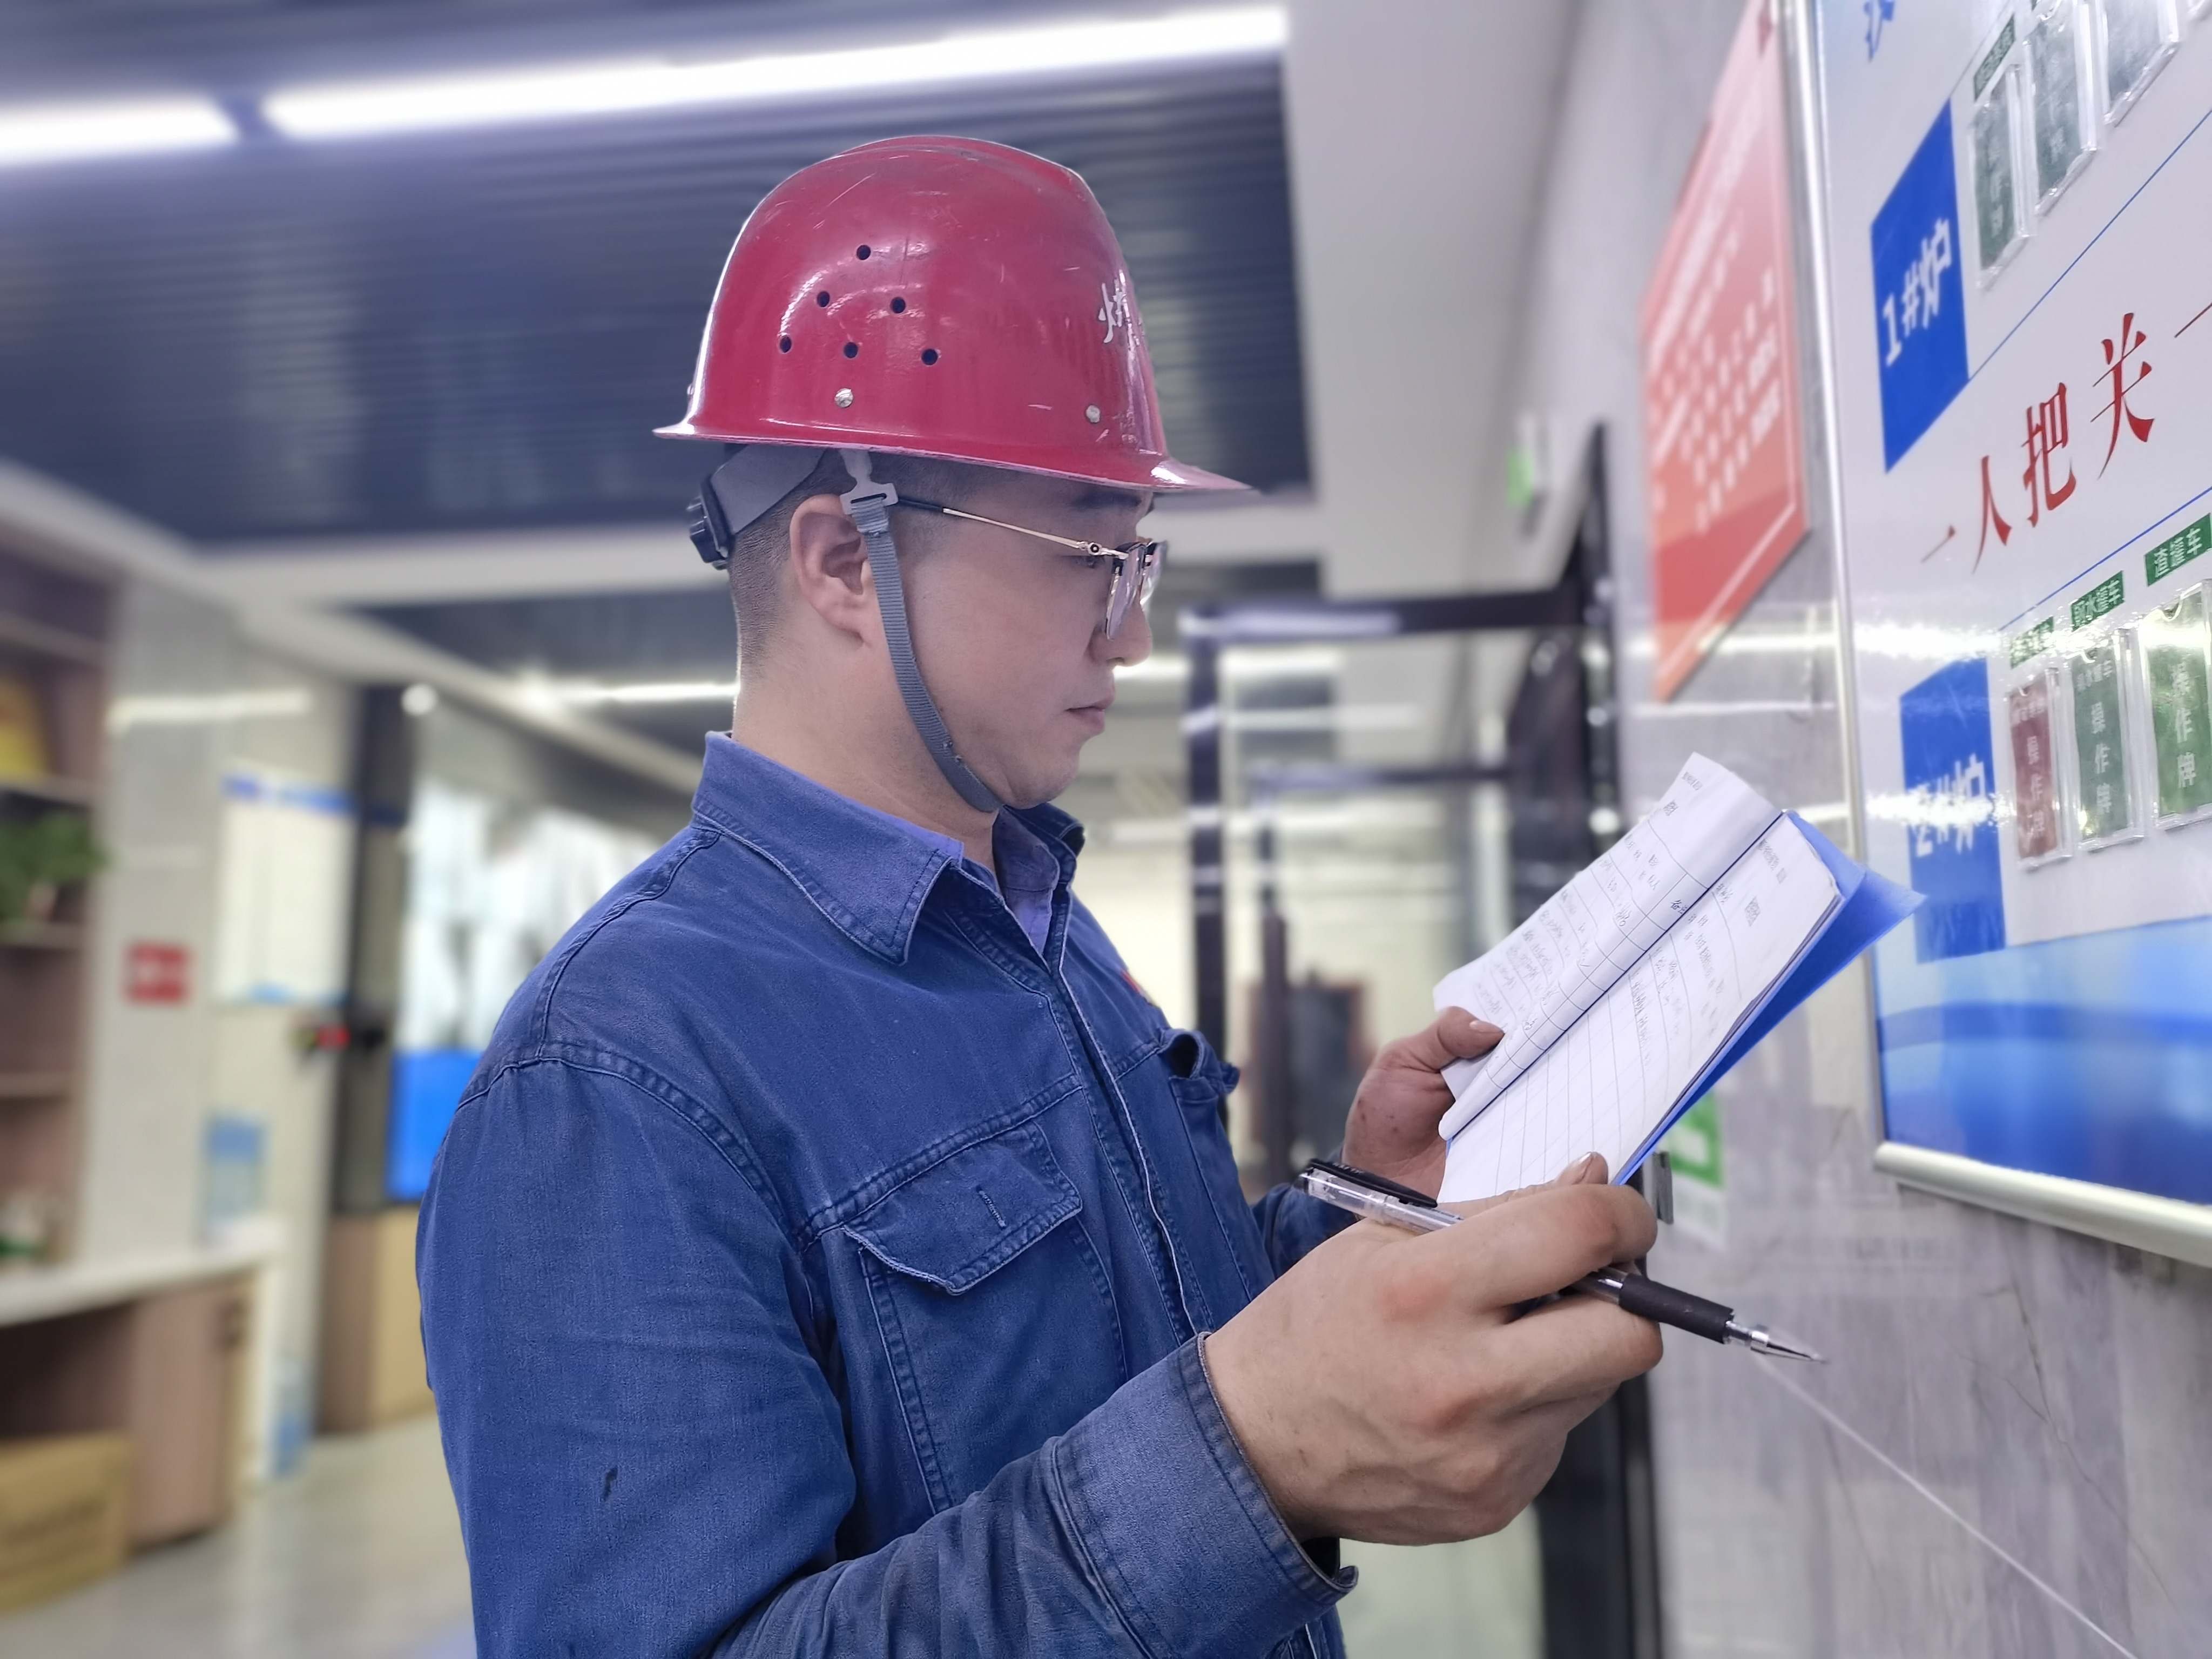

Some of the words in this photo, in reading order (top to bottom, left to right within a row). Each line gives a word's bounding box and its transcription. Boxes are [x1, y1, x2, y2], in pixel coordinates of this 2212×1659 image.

[1883, 217, 1952, 367] 1#炉
[2154, 528, 2202, 577] 渣罐车
[2090, 702, 2111, 815] 操作牌
[2171, 662, 2196, 788] 操作牌
